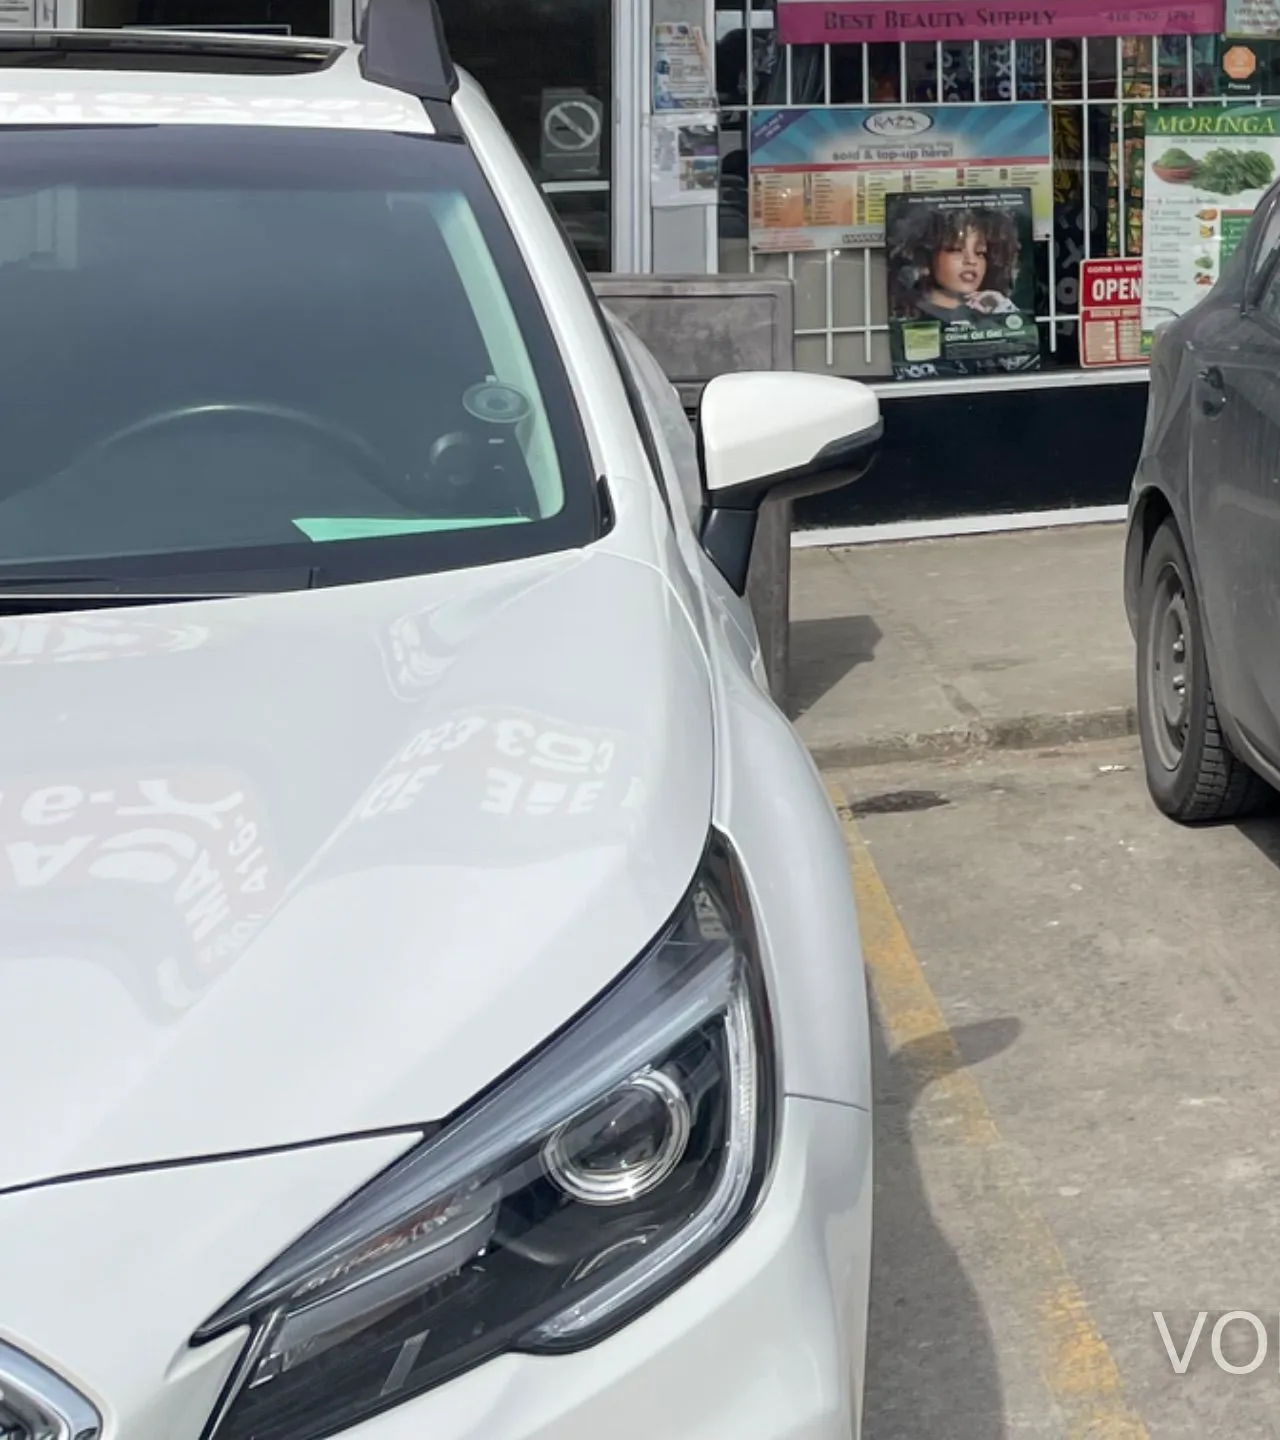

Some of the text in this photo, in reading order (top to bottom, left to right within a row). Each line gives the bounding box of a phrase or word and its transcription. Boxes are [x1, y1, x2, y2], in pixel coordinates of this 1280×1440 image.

[824, 7, 1057, 30] BEST BEAUTY SUPPLY
[1153, 116, 1277, 134] MORINGA
[1092, 278, 1142, 301] OPEN
